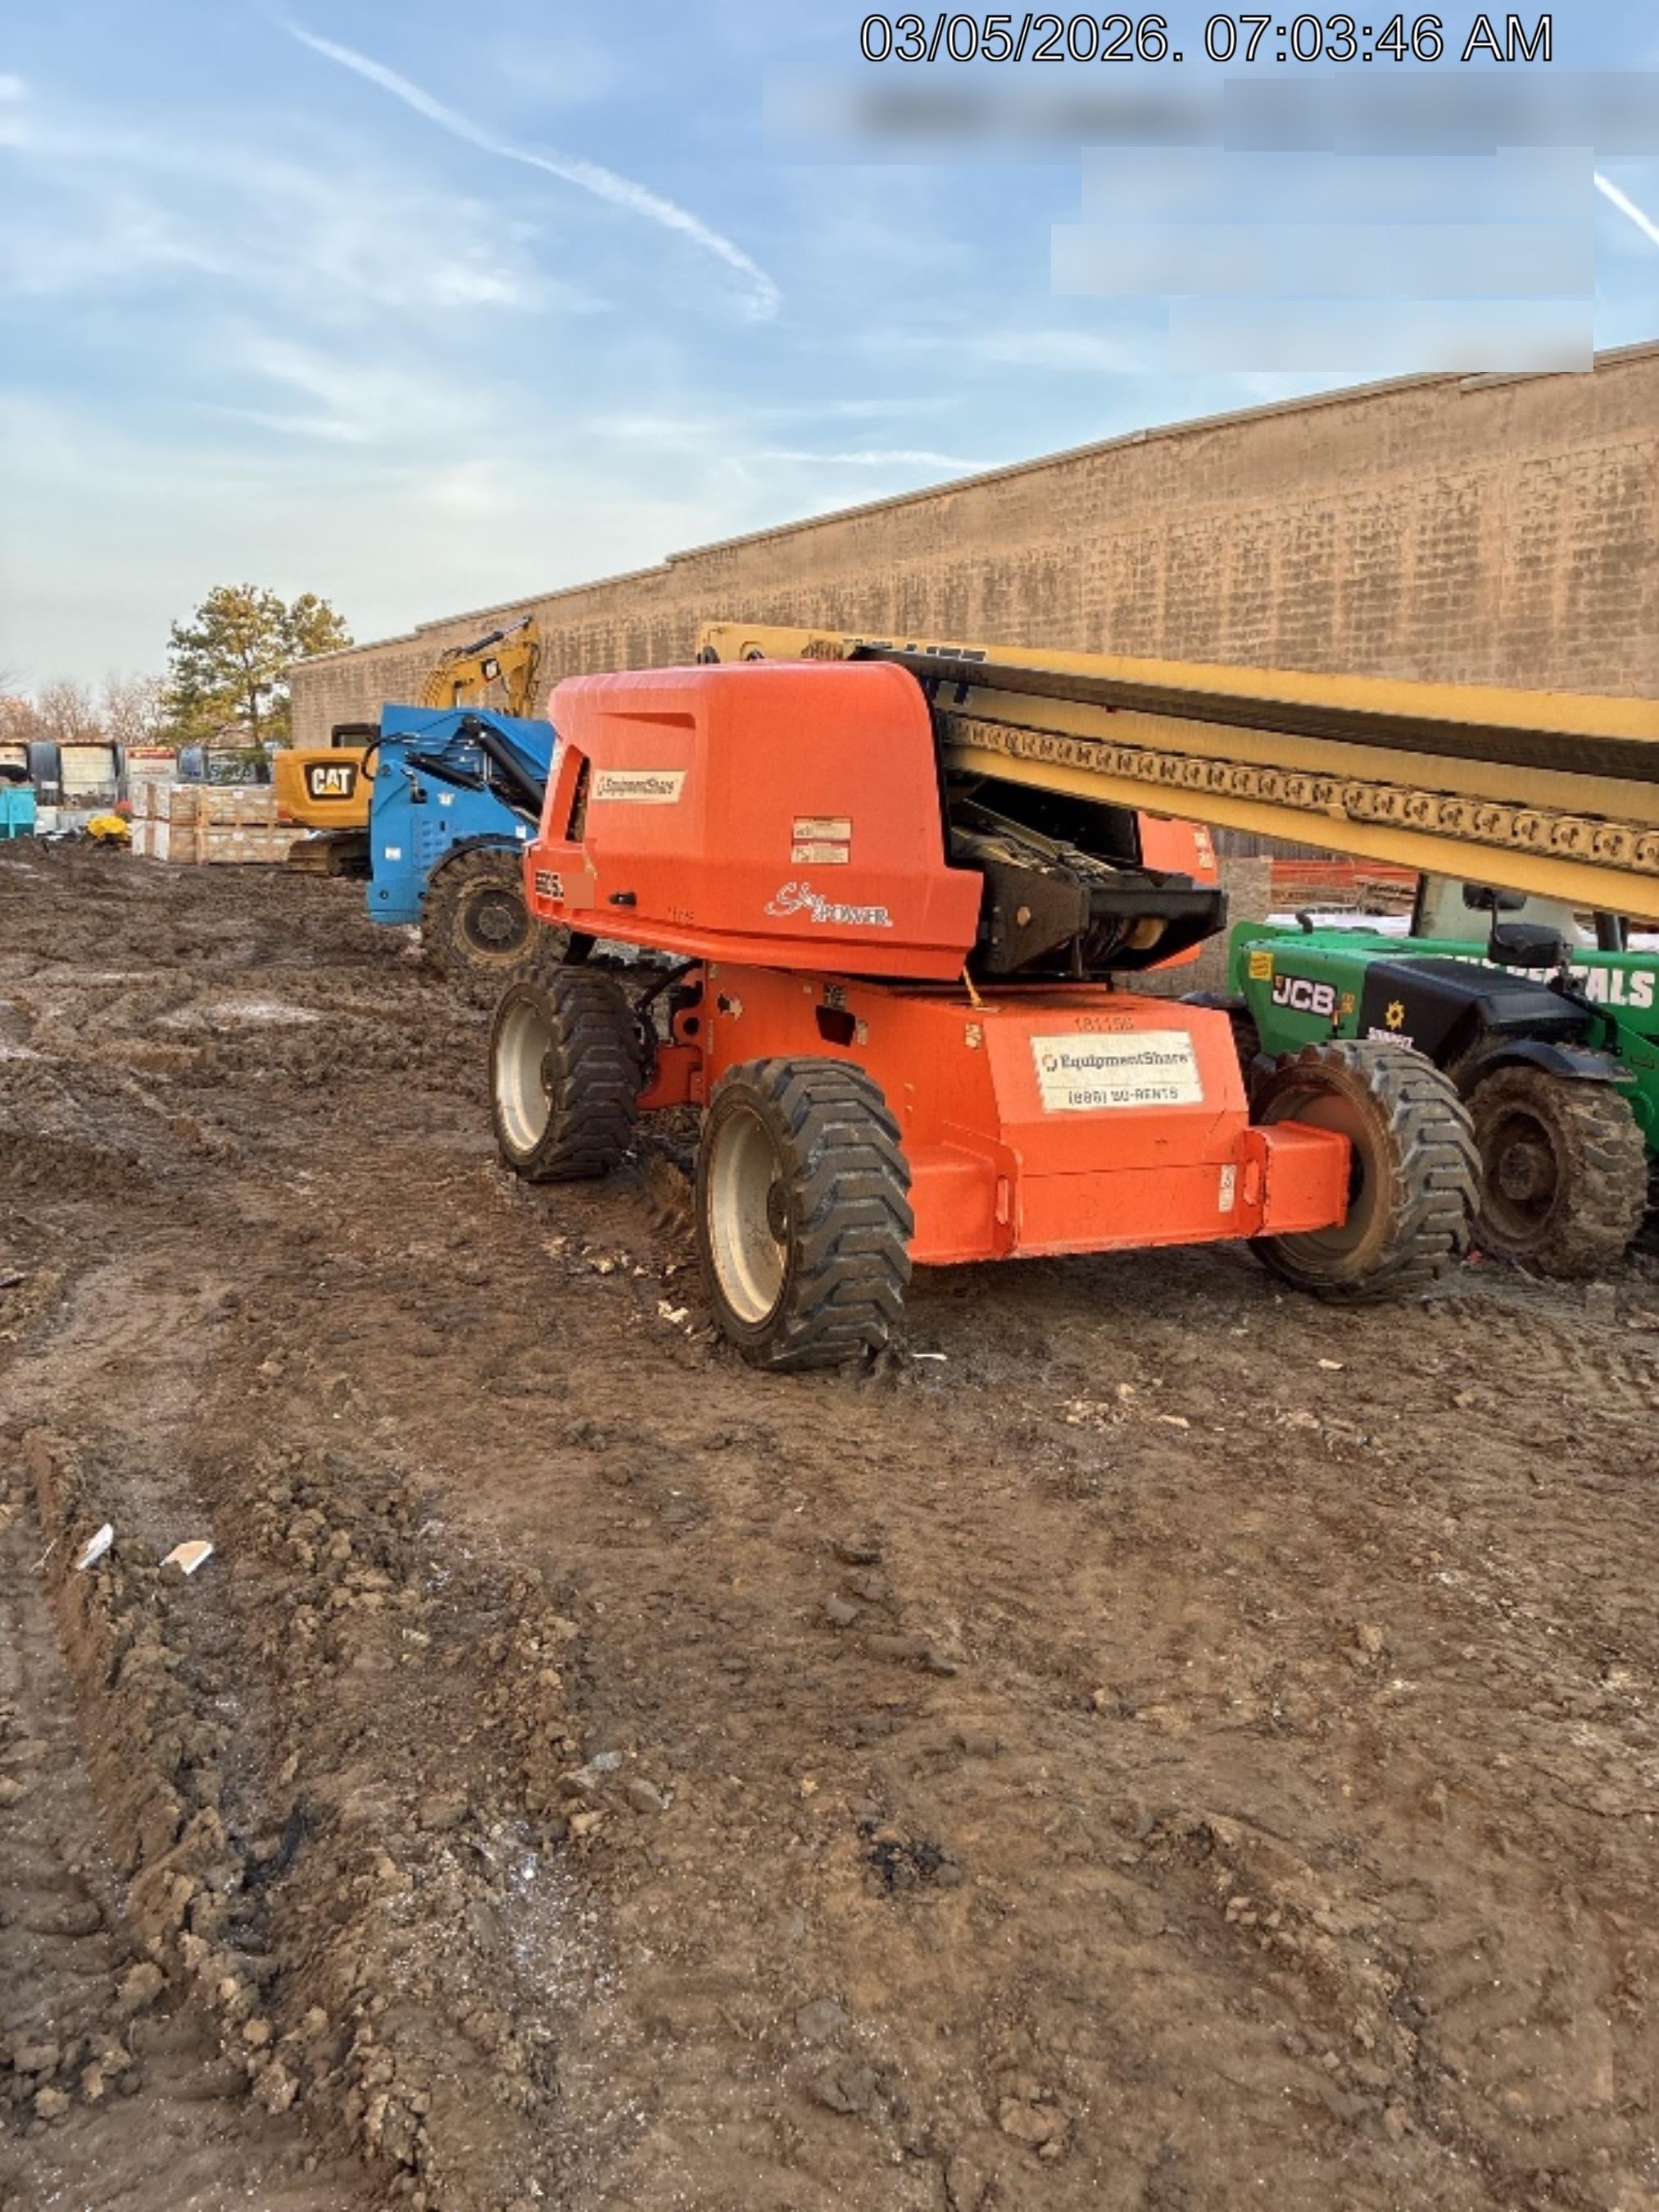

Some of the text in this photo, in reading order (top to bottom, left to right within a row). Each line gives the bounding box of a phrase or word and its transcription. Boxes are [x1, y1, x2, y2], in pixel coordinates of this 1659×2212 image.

[311, 768, 352, 796] CAT
[1272, 977, 1336, 1016] JCB
[1058, 1051, 1188, 1071] EquipmentShare
